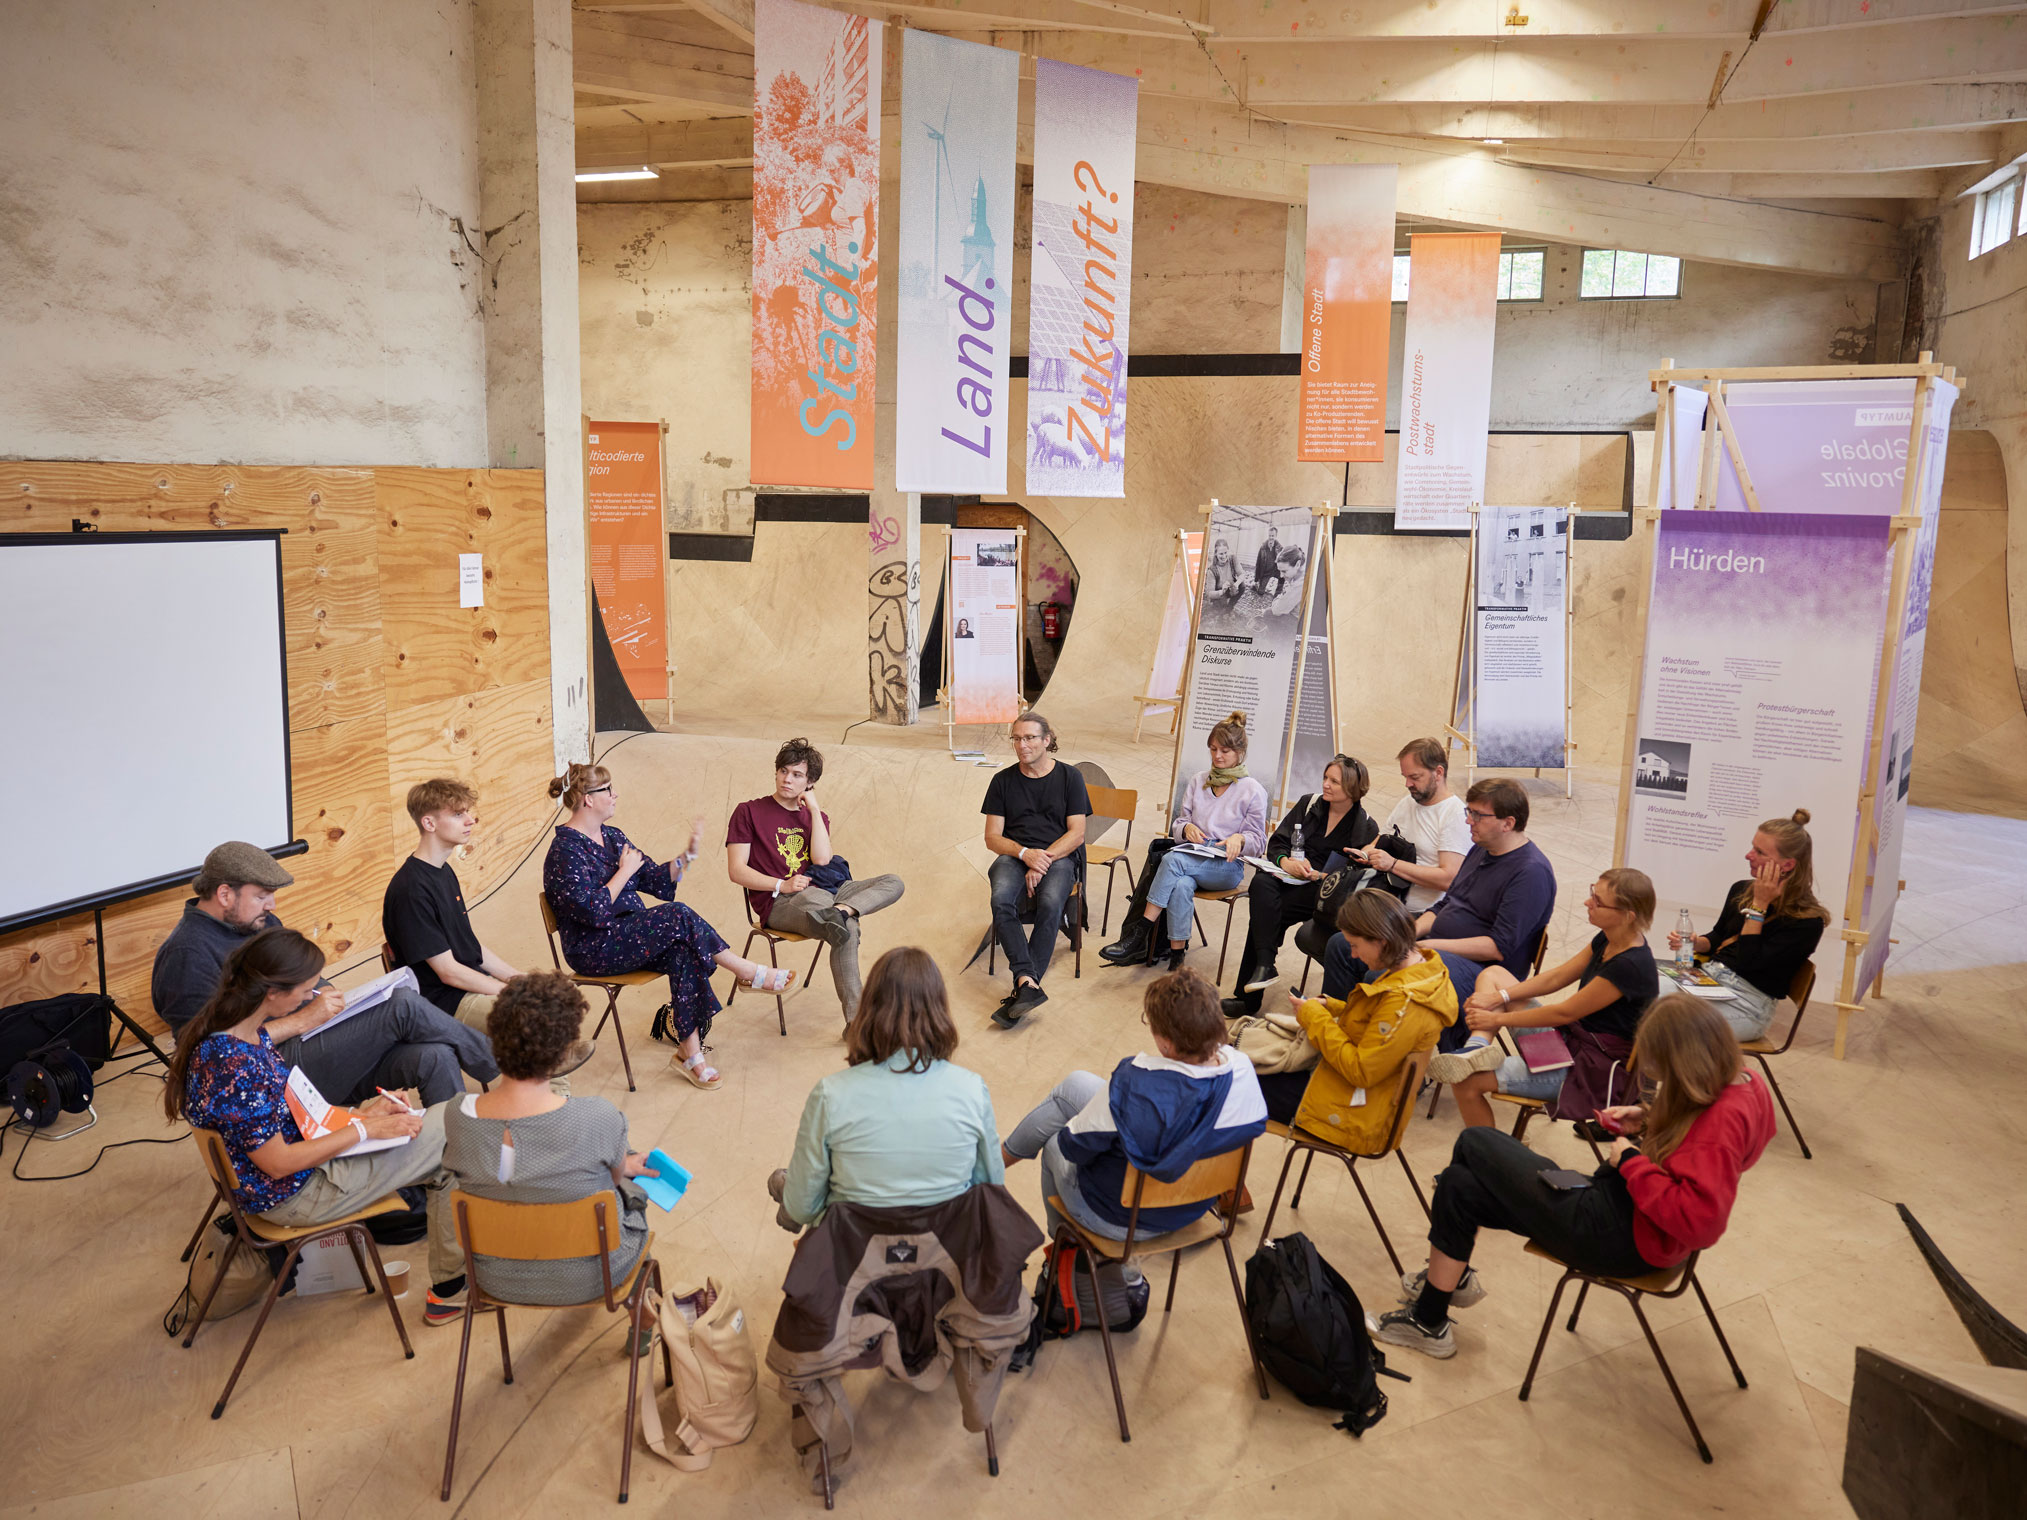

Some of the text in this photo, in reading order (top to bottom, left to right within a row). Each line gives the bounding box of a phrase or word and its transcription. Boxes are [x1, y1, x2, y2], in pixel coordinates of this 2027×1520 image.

[1067, 160, 1119, 463] Zukunft?
[1308, 288, 1324, 373] Offene Stadt
[800, 241, 860, 450] Stadt.
[941, 274, 995, 458] Land.
[1406, 349, 1424, 456] Postwachstums-
[1423, 421, 1436, 456] stadt
[589, 450, 645, 462] lticodierte
[1669, 547, 1765, 573] Hürden
[1484, 614, 1548, 622] Gemeinschaftliches
[1484, 622, 1515, 631] Eigentum
[1203, 644, 1276, 659] Grenzüberwindende
[1201, 655, 1232, 666] Diskurse
[1661, 656, 1700, 666] Wachstum
[1660, 666, 1711, 676] ohne Visionen
[1757, 702, 1836, 717] Protestbürgerschaft
[1647, 804, 1709, 820] Wohlstandsreflex
